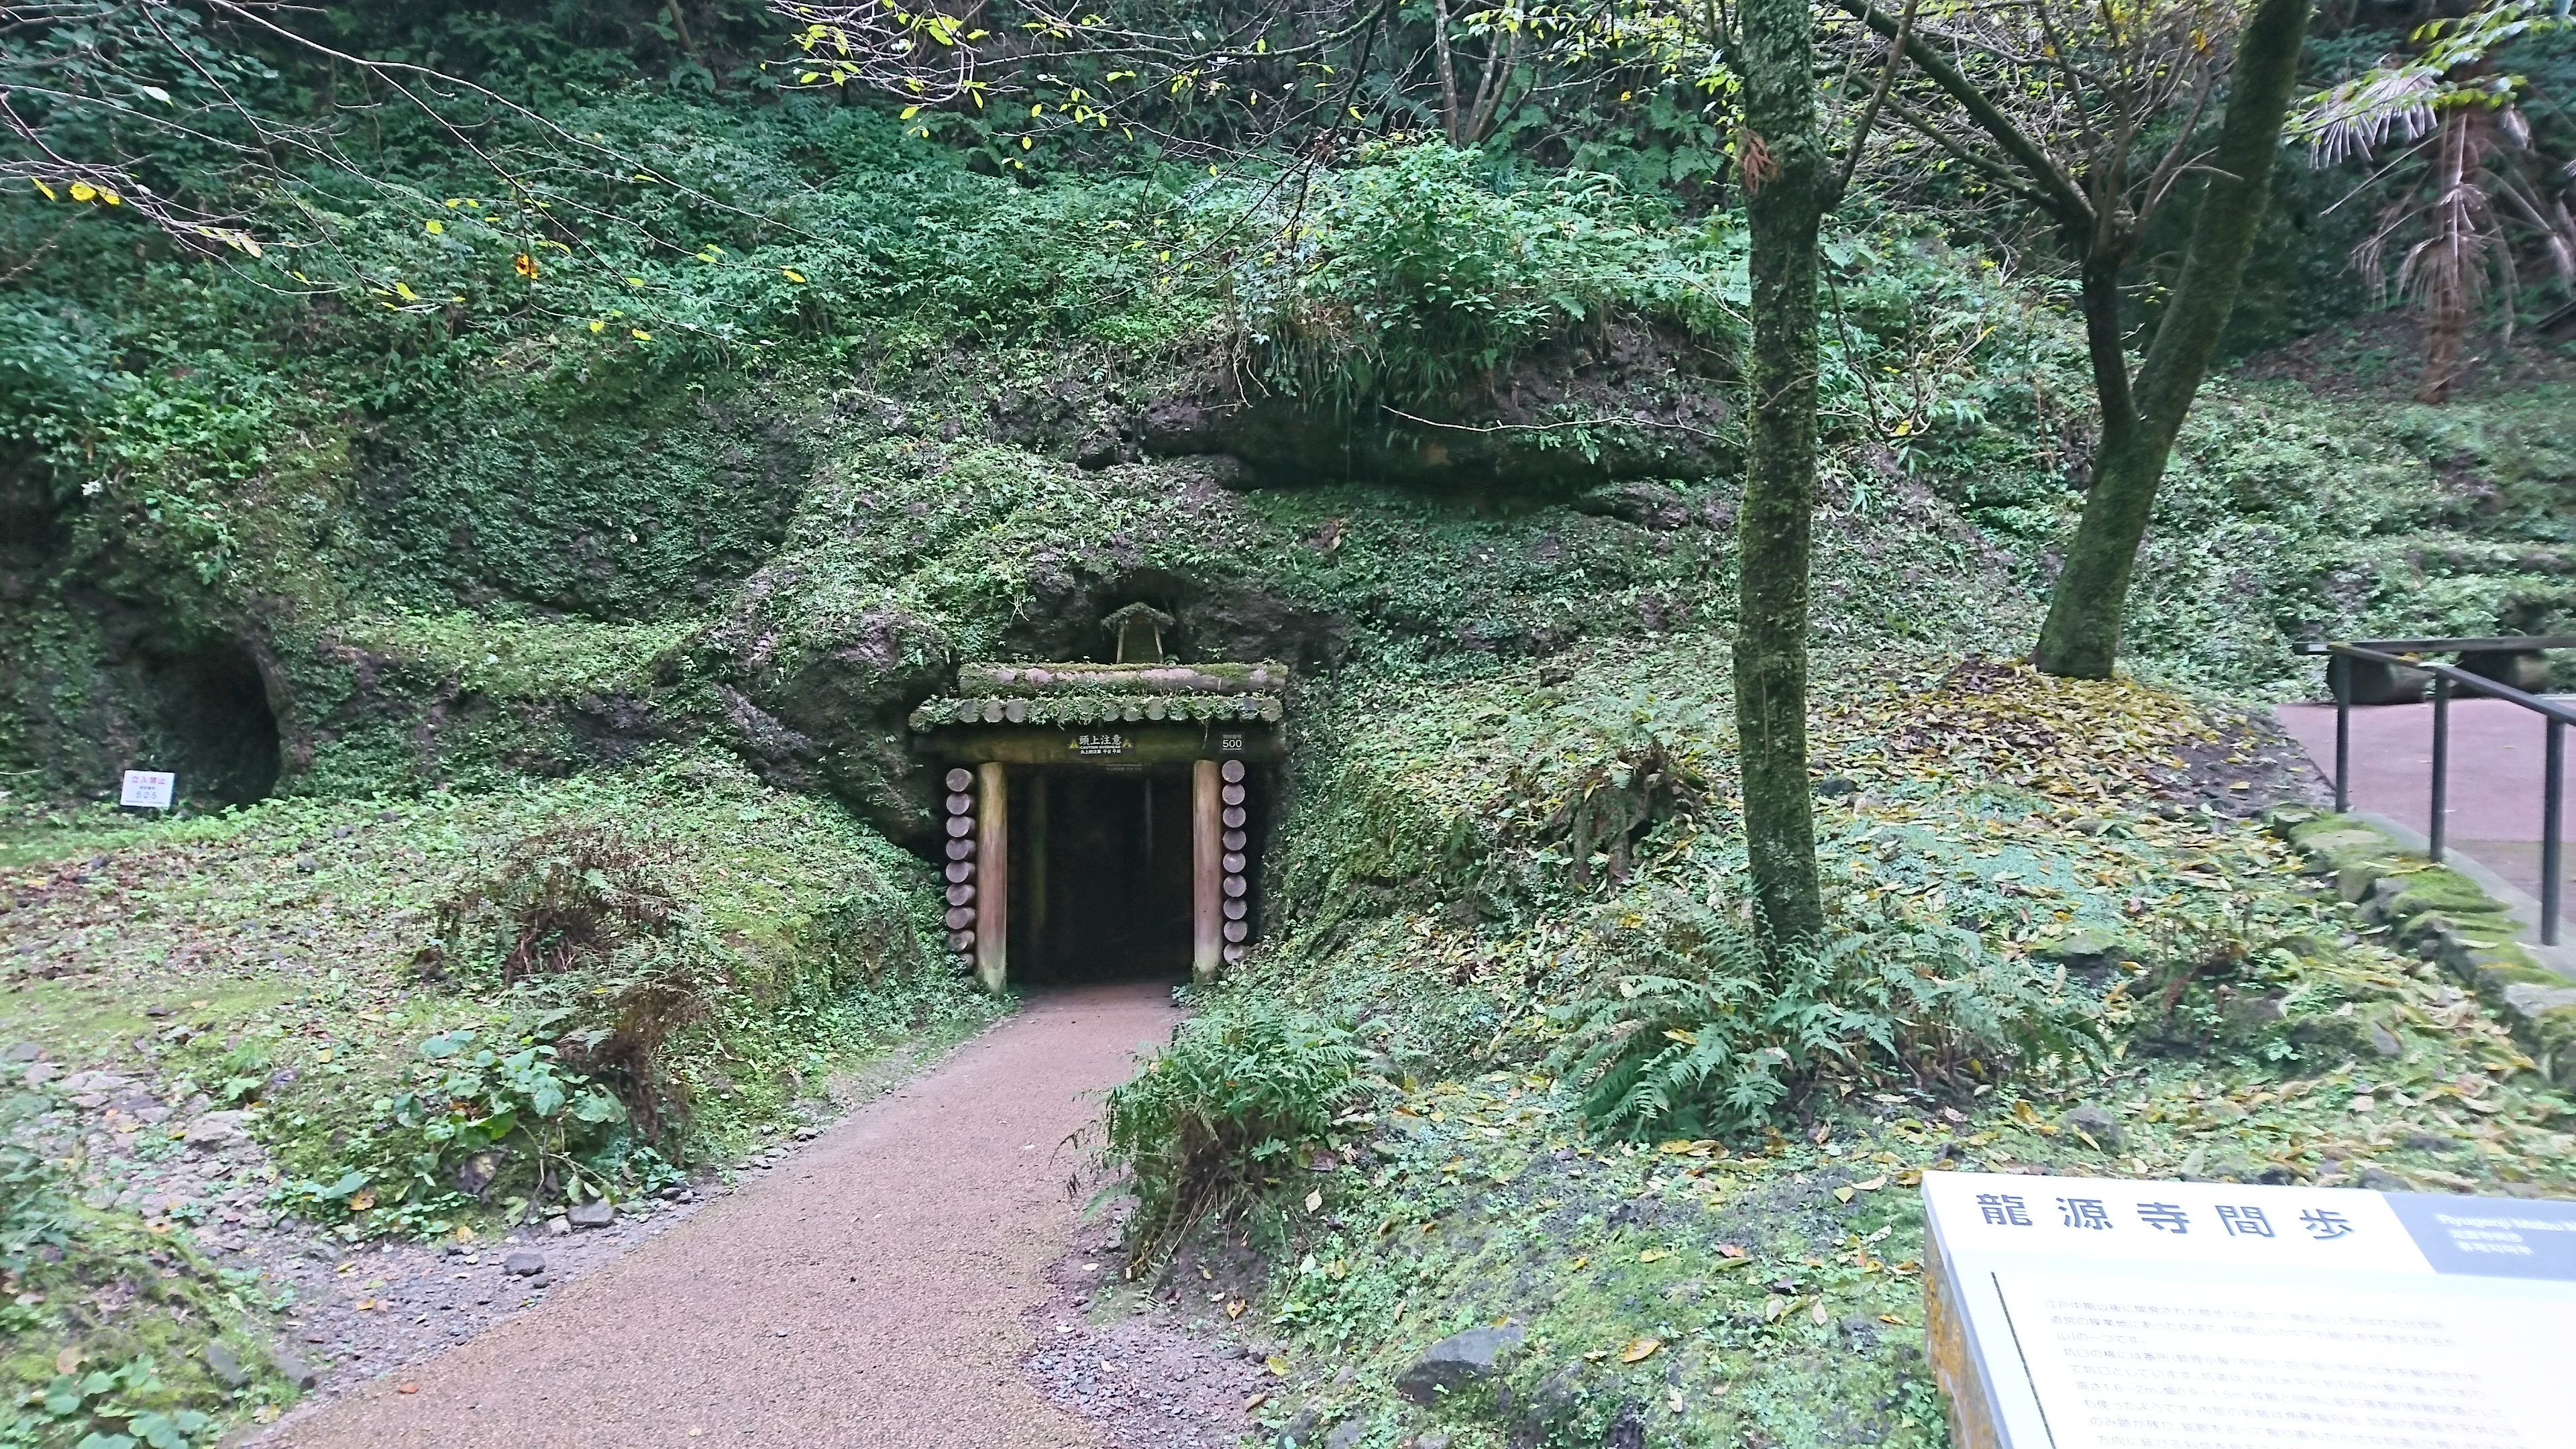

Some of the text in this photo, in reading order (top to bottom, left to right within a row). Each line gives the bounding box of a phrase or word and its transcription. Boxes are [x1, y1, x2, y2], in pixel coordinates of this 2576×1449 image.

[1079, 734, 1122, 746] 頭上注意
[1222, 739, 1242, 748] 500
[131, 776, 165, 785] 立入禁止
[1976, 1193, 2358, 1240] 龍源寺間歩
[2437, 1214, 2512, 1230] Ryugenji
[2512, 1218, 2564, 1232] Mabu
